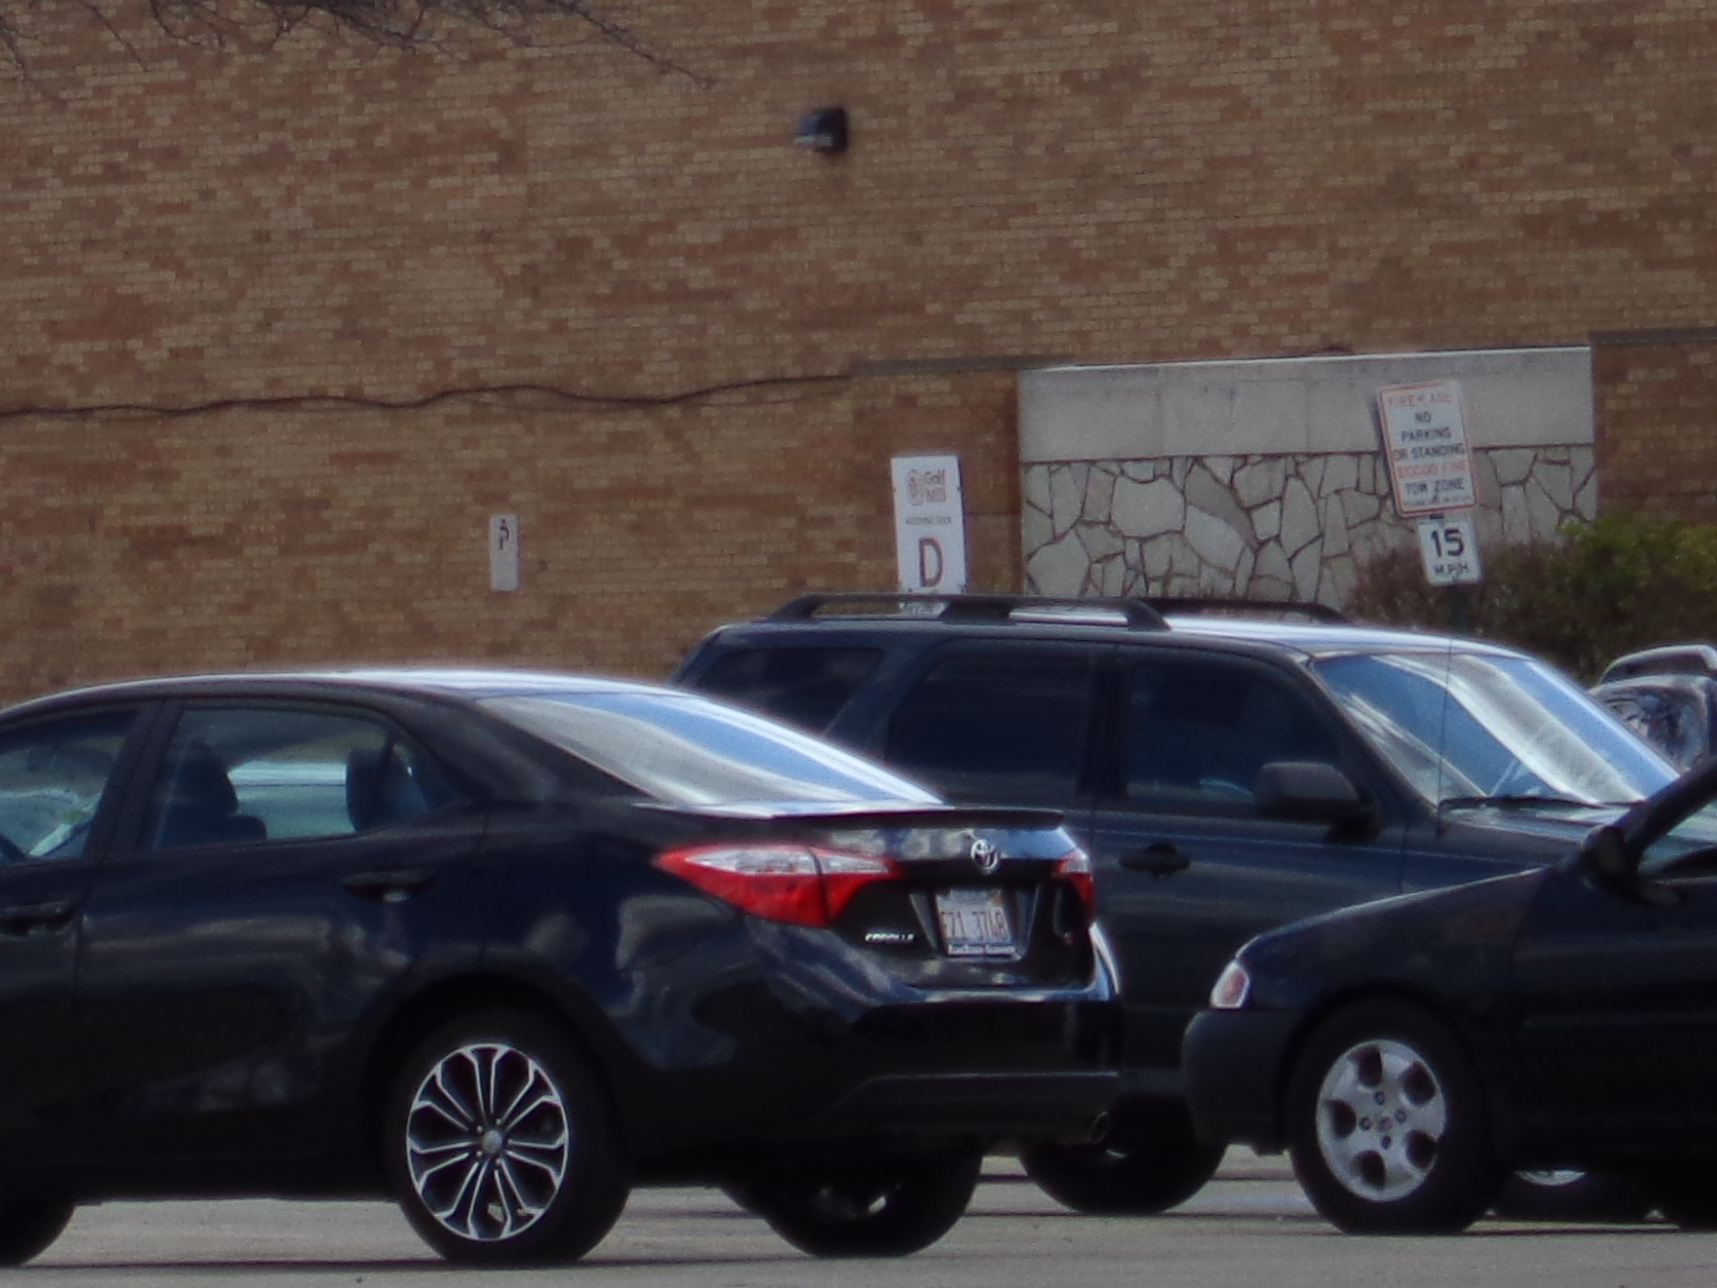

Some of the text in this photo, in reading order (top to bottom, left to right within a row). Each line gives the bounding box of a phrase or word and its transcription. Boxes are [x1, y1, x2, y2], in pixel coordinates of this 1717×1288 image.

[1414, 410, 1432, 424] NO
[1401, 426, 1452, 442] PARKING
[1394, 442, 1465, 461] OR STANDING
[924, 469, 946, 485] Golf
[1406, 477, 1465, 495] TOW ZONE
[1430, 528, 1464, 558] 15
[918, 537, 944, 588] D
